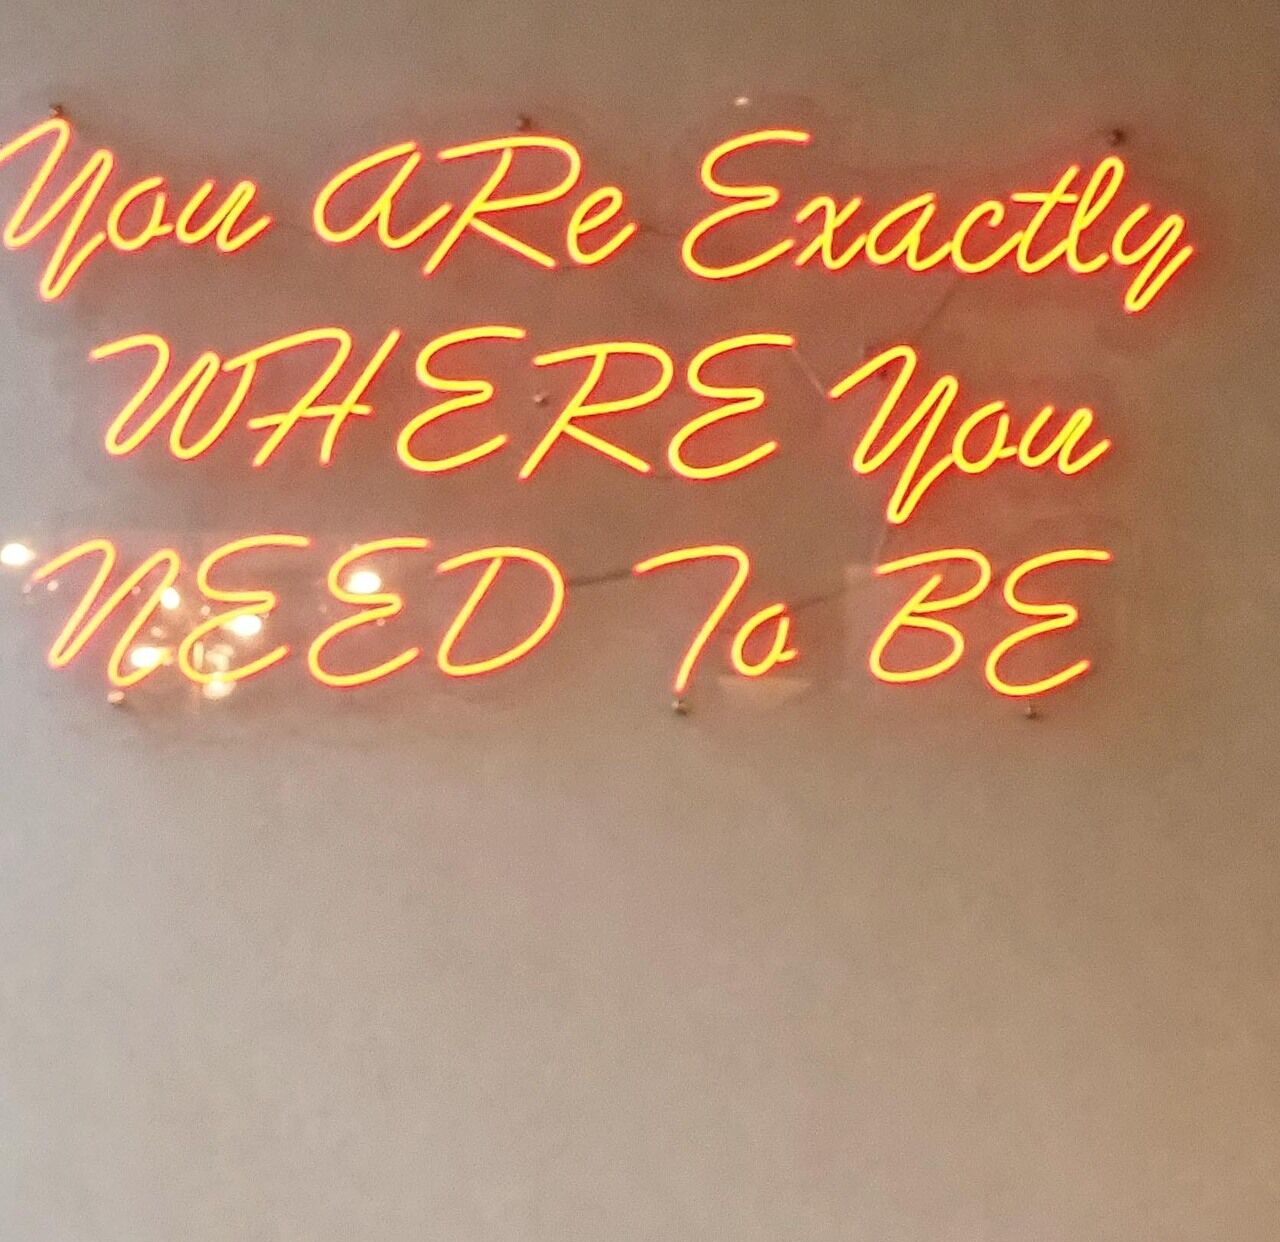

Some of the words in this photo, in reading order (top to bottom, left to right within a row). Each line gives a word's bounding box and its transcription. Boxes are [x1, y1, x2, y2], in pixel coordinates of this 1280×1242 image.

[680, 129, 1195, 315] Exactly
[88, 325, 797, 481] WHERE
[828, 345, 1112, 524] You
[27, 533, 568, 690] NEED
[633, 544, 799, 693] To
[868, 547, 1111, 697] BE
